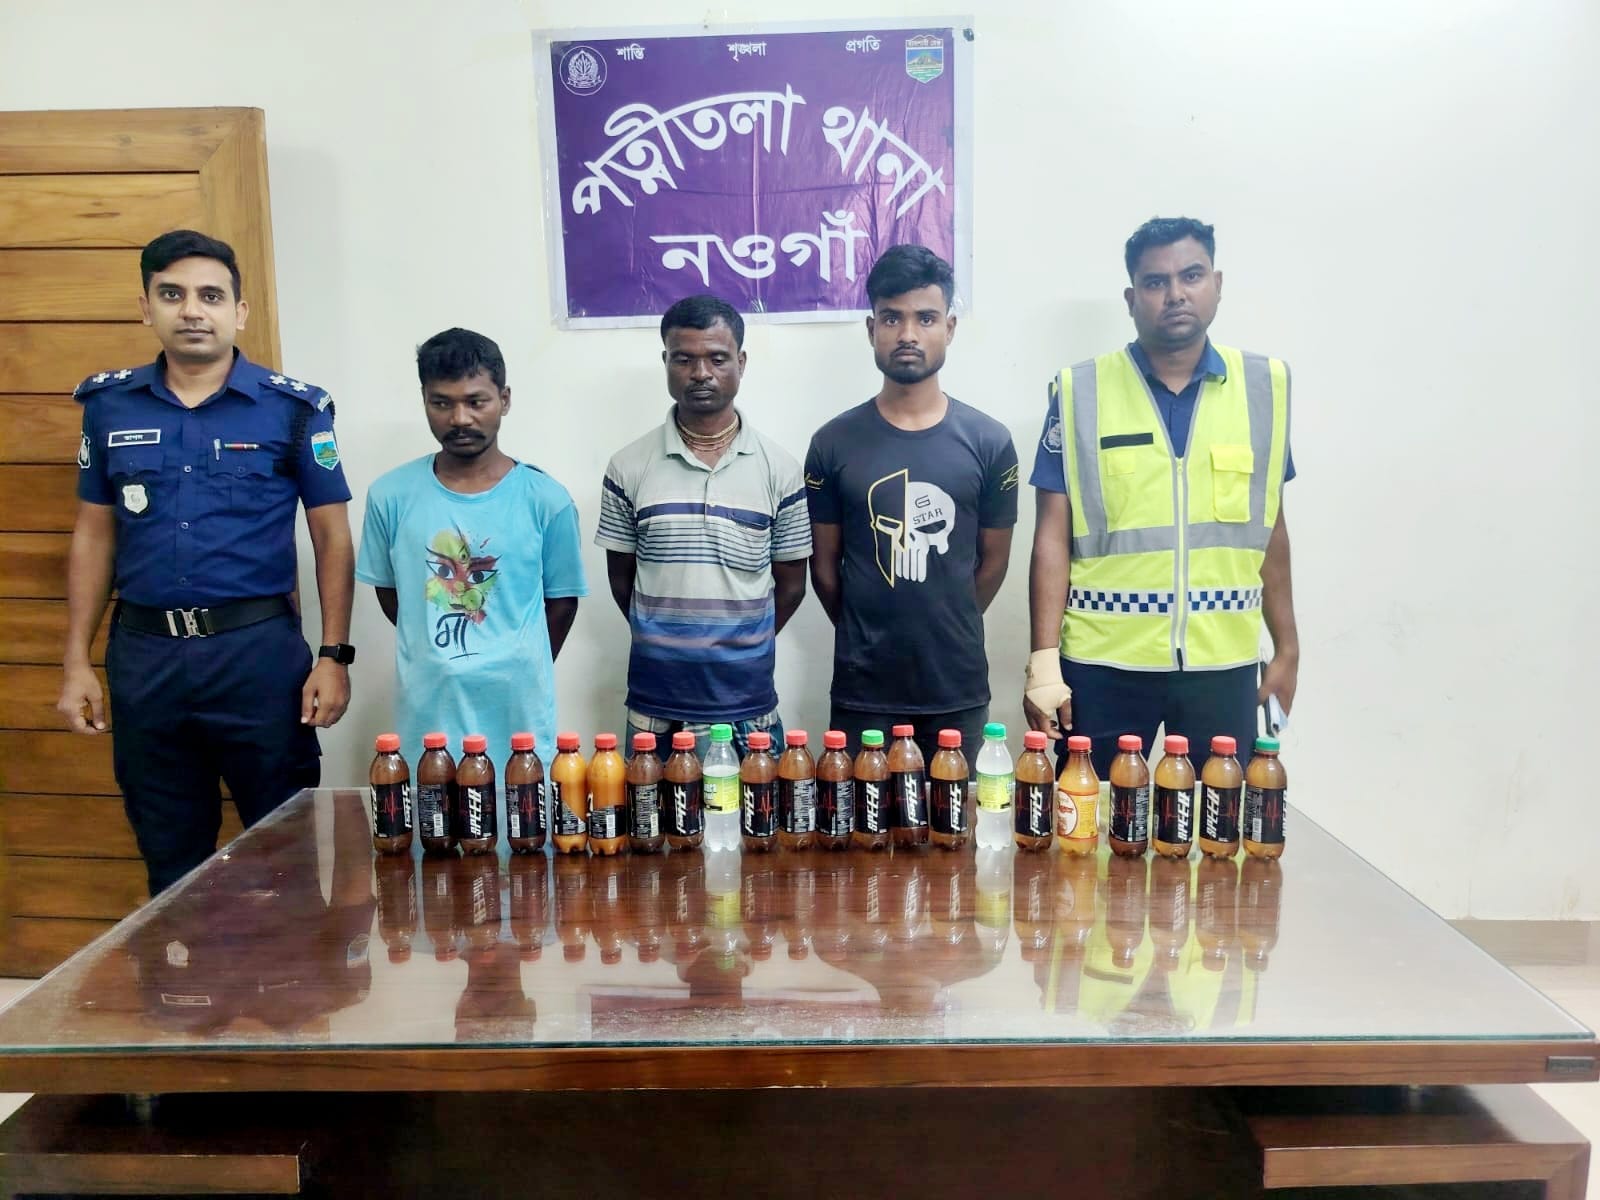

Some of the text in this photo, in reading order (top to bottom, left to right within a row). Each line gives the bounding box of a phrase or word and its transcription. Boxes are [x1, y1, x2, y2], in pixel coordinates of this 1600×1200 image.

[616, 35, 882, 62] শান্তি শৃঙ্খলা প্রগতি
[572, 82, 947, 220] পত্নীতলা থানা
[649, 210, 870, 287] নওগাঁ
[912, 507, 943, 525] STAR
[468, 786, 482, 837] SPEED
[866, 782, 880, 832] SPEED
[1177, 791, 1190, 841] SPEED
[1206, 787, 1220, 838] SPEED
